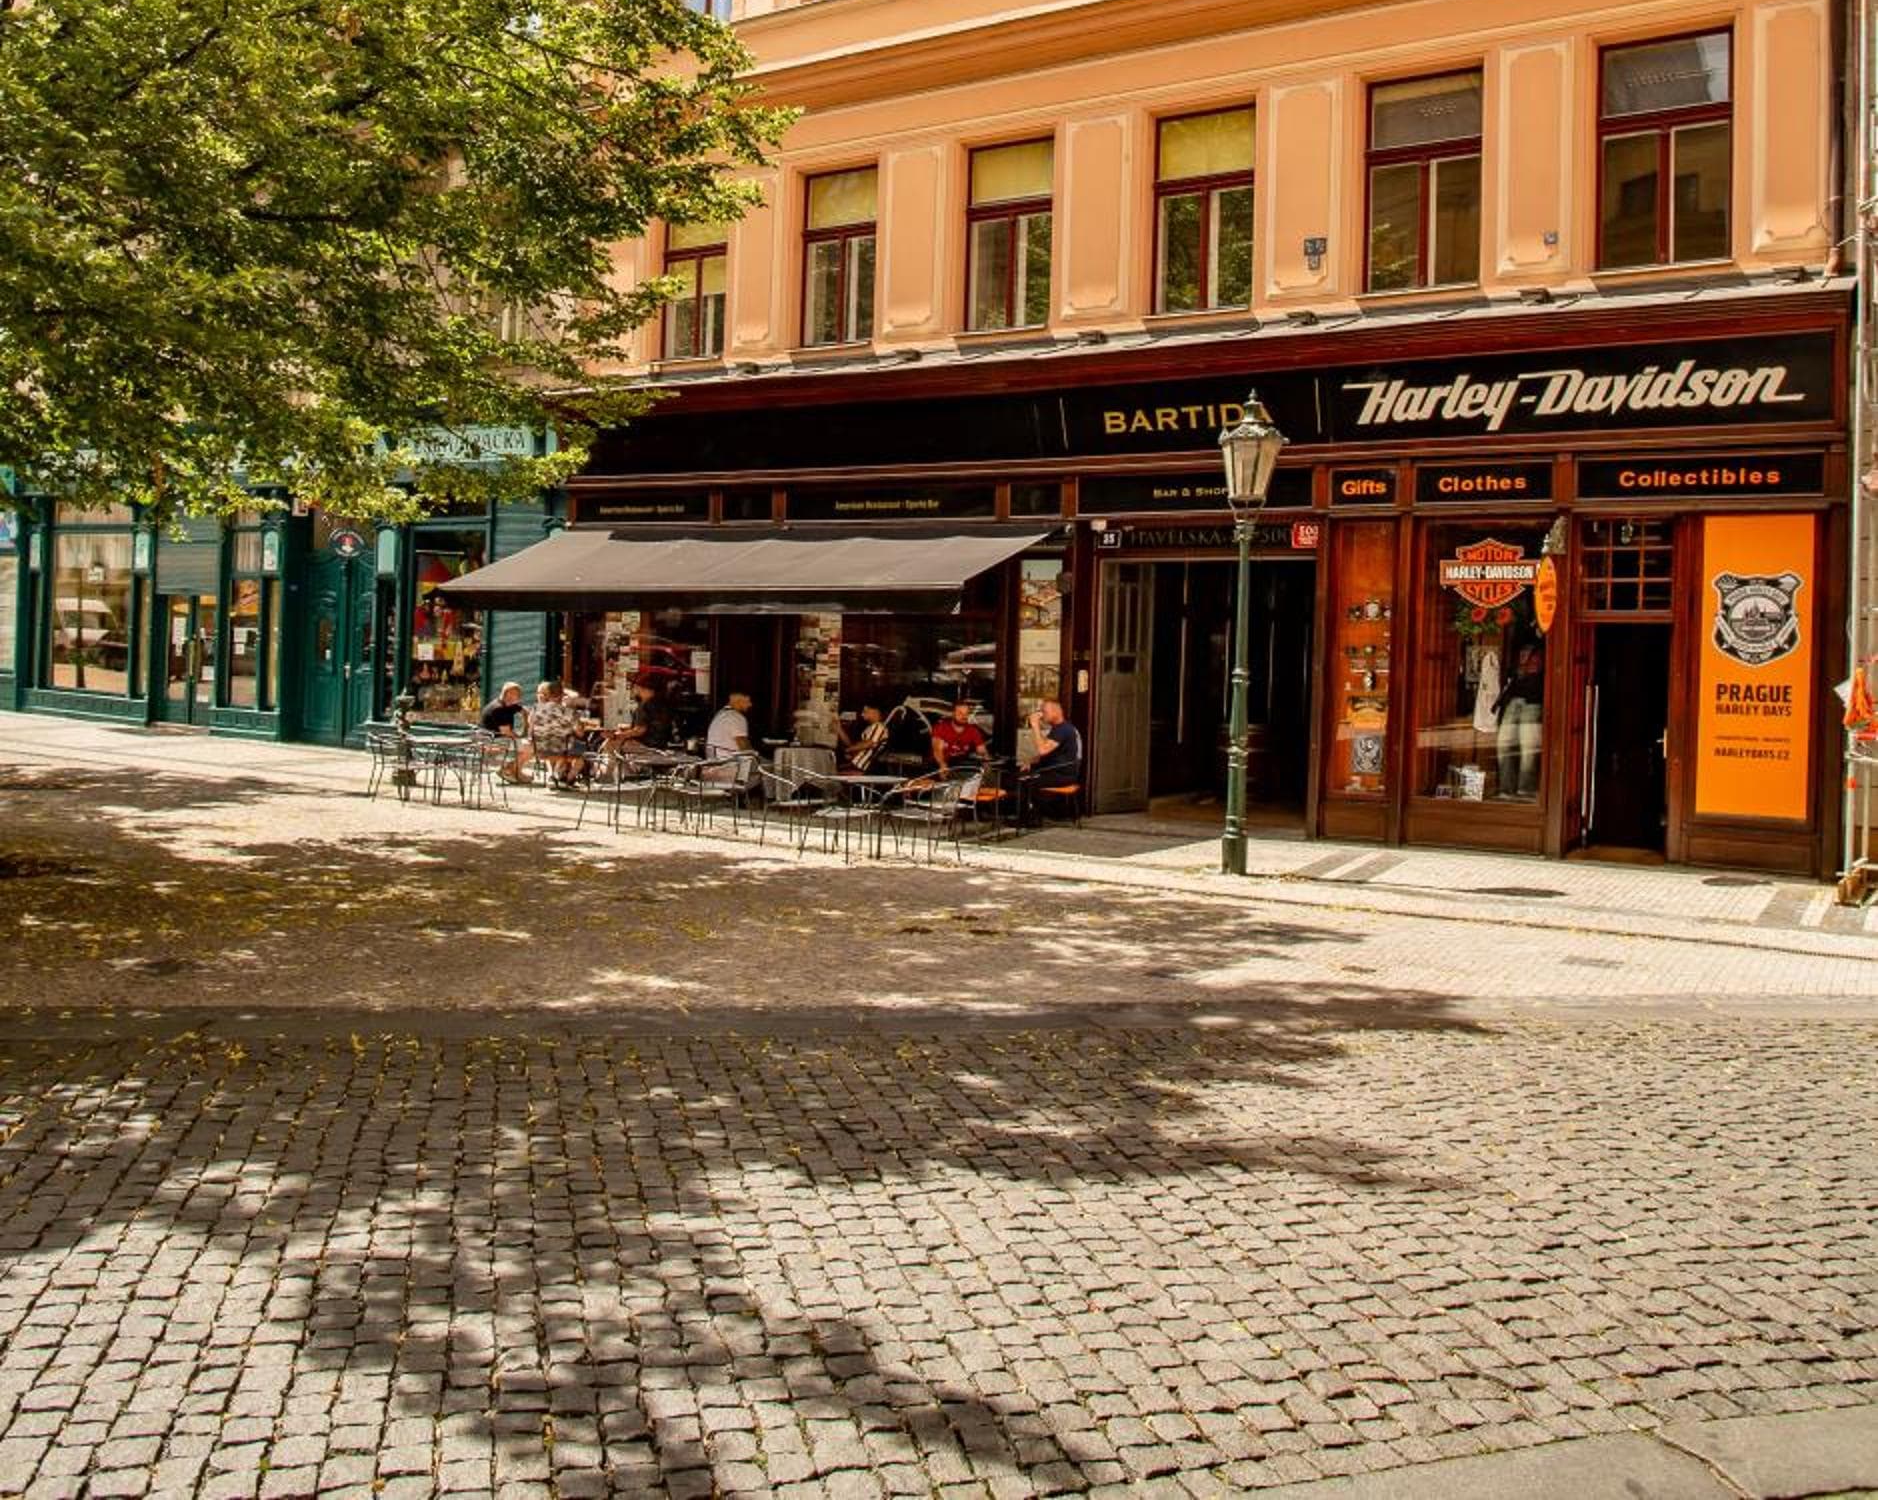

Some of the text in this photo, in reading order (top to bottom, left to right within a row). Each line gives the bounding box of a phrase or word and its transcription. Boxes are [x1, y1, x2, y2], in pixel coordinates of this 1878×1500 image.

[1342, 359, 1806, 431] Harley-Davidson
[1438, 475, 1527, 492] Clothes
[1619, 468, 1781, 488] Collectibles
[1342, 479, 1387, 495] Gifts
[1446, 565, 1535, 579] HARLEY-DAVIDSON
[1716, 683, 1792, 703] PRAGUE
[1716, 703, 1792, 717] HARLEY DAYS
